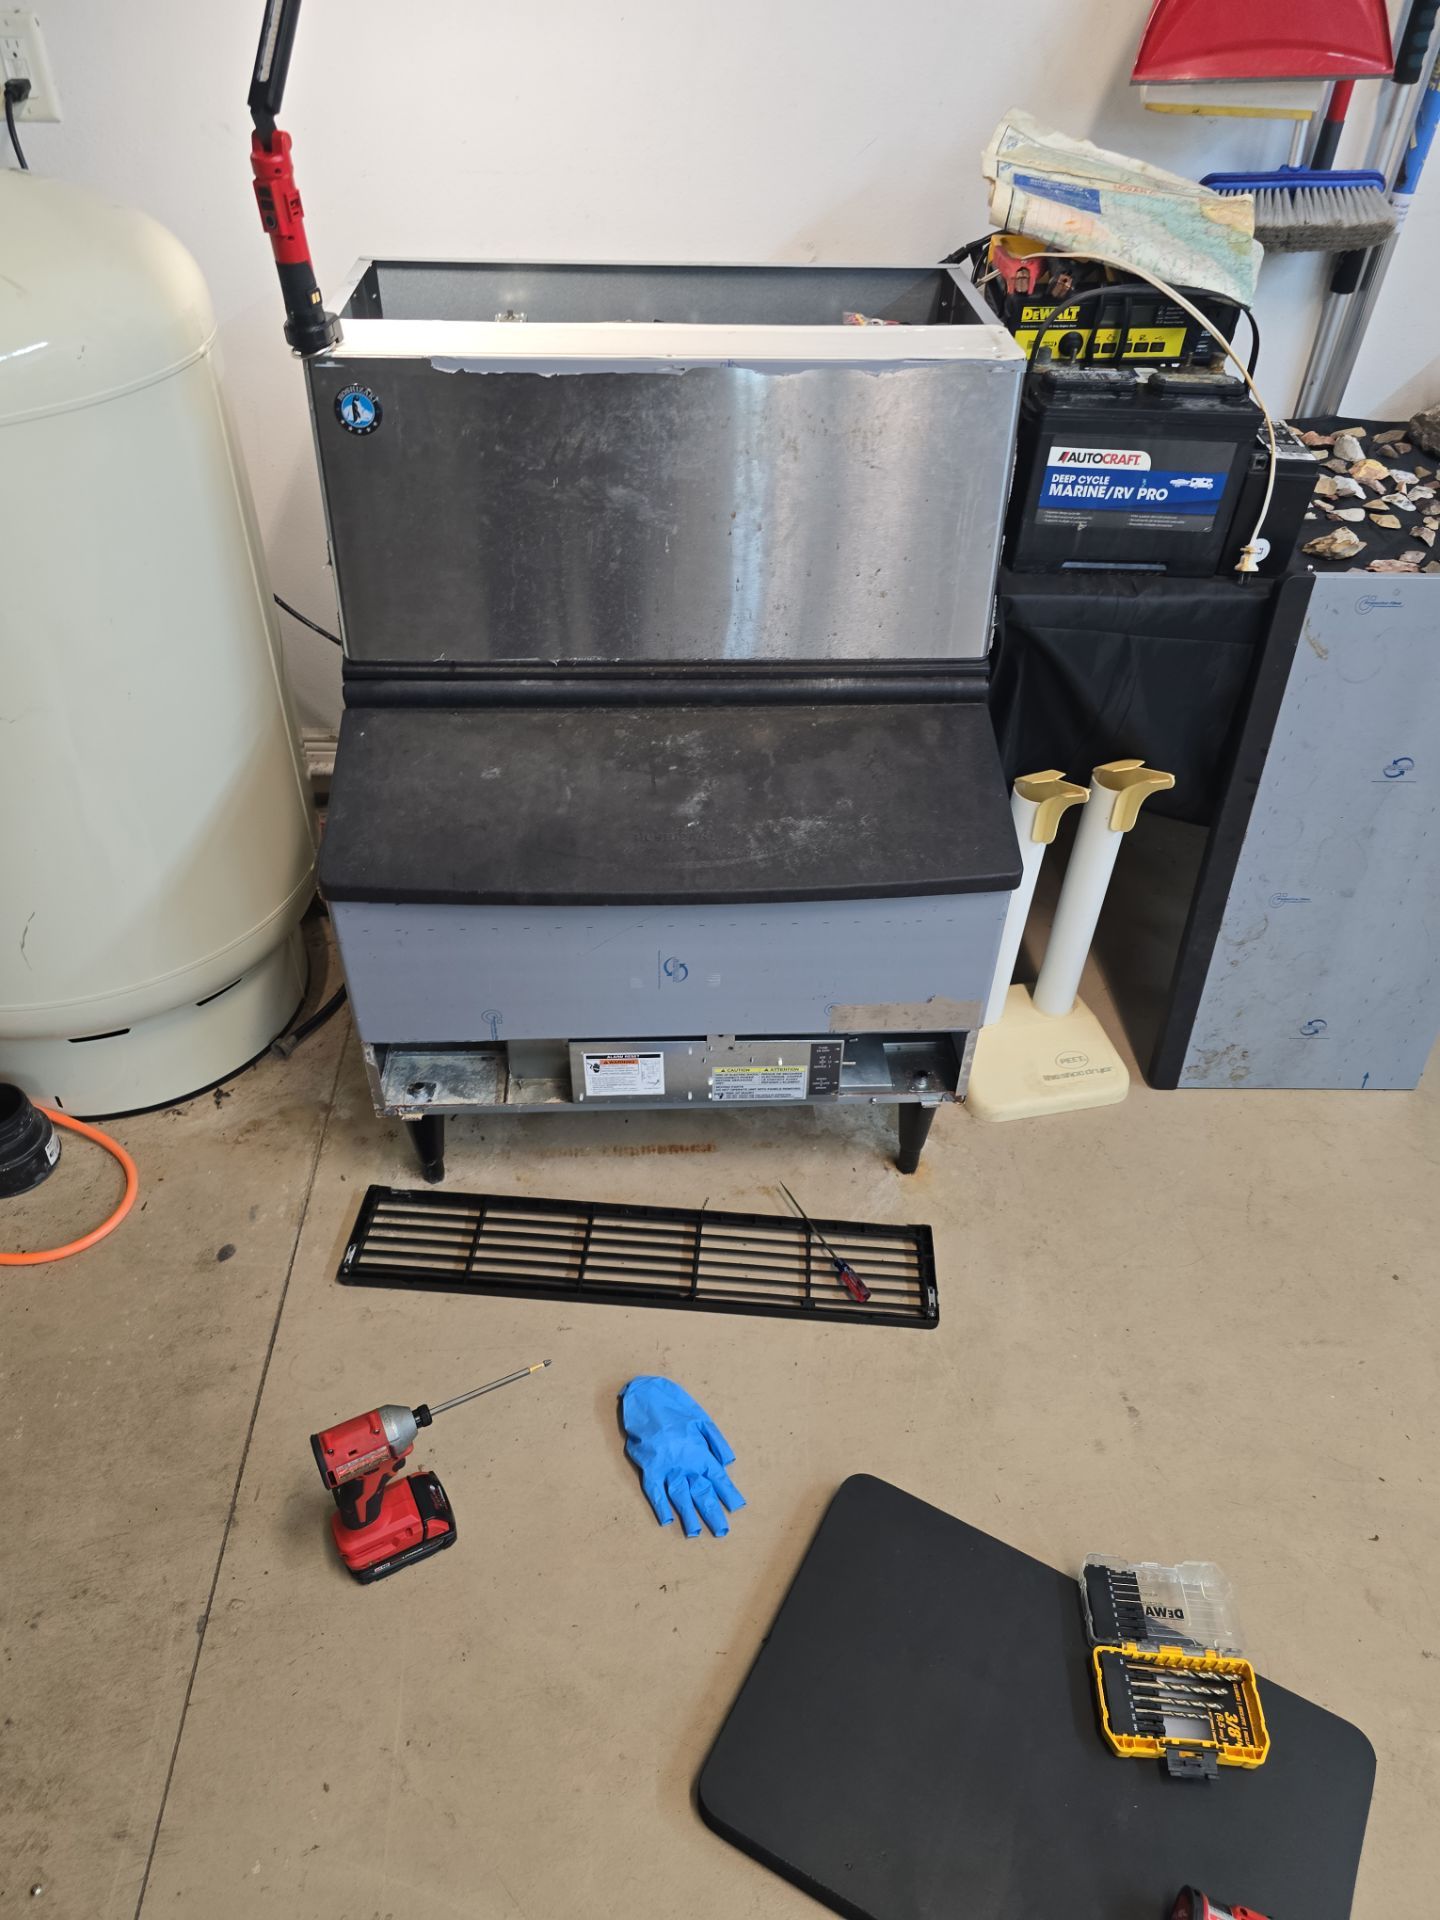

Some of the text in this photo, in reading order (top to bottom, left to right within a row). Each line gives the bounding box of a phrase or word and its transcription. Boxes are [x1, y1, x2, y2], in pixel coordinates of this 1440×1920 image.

[1067, 452, 1142, 466] AUTOCRAFT
[1051, 474, 1111, 486] DEEP CYCLE
[1048, 483, 1169, 501] MARINE/RV PRO
